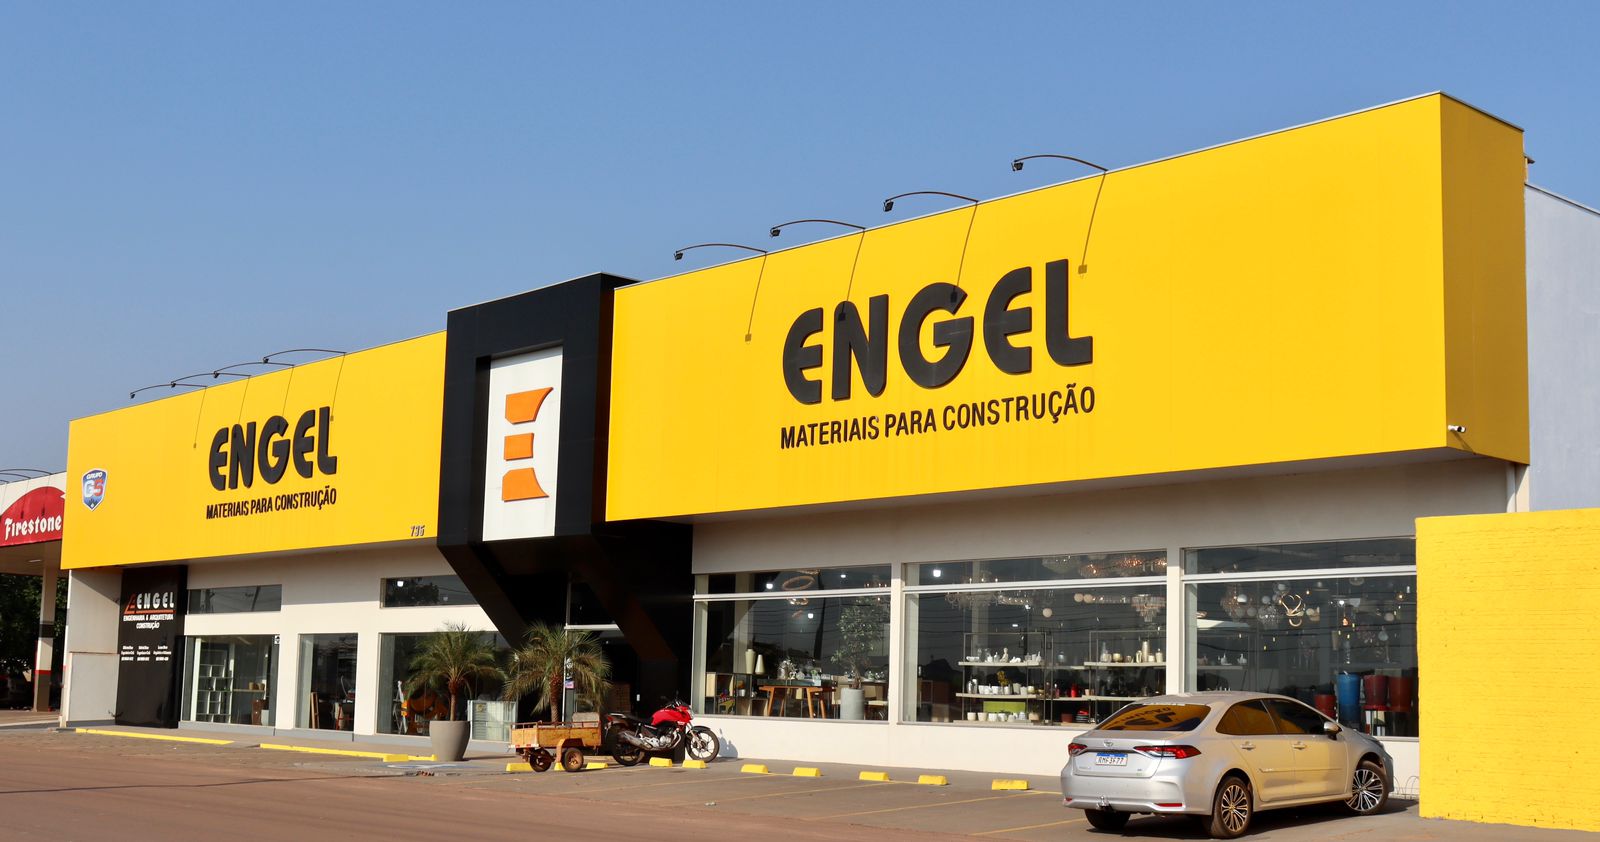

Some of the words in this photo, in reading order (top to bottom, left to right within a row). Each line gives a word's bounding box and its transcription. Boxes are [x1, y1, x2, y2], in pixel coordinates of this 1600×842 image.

[782, 258, 1094, 405] ENGEL
[781, 415, 880, 449] MATERIAIS
[885, 408, 937, 438] PARA
[942, 383, 1096, 431] CONSTRUÇÃO
[208, 406, 338, 491] ENGEL
[206, 500, 249, 520] MATERIAIS
[250, 497, 273, 515] PARA
[274, 485, 337, 512] CONSTRUÇÃO
[4, 515, 62, 541] Firestone
[136, 592, 175, 609] ENGEL
